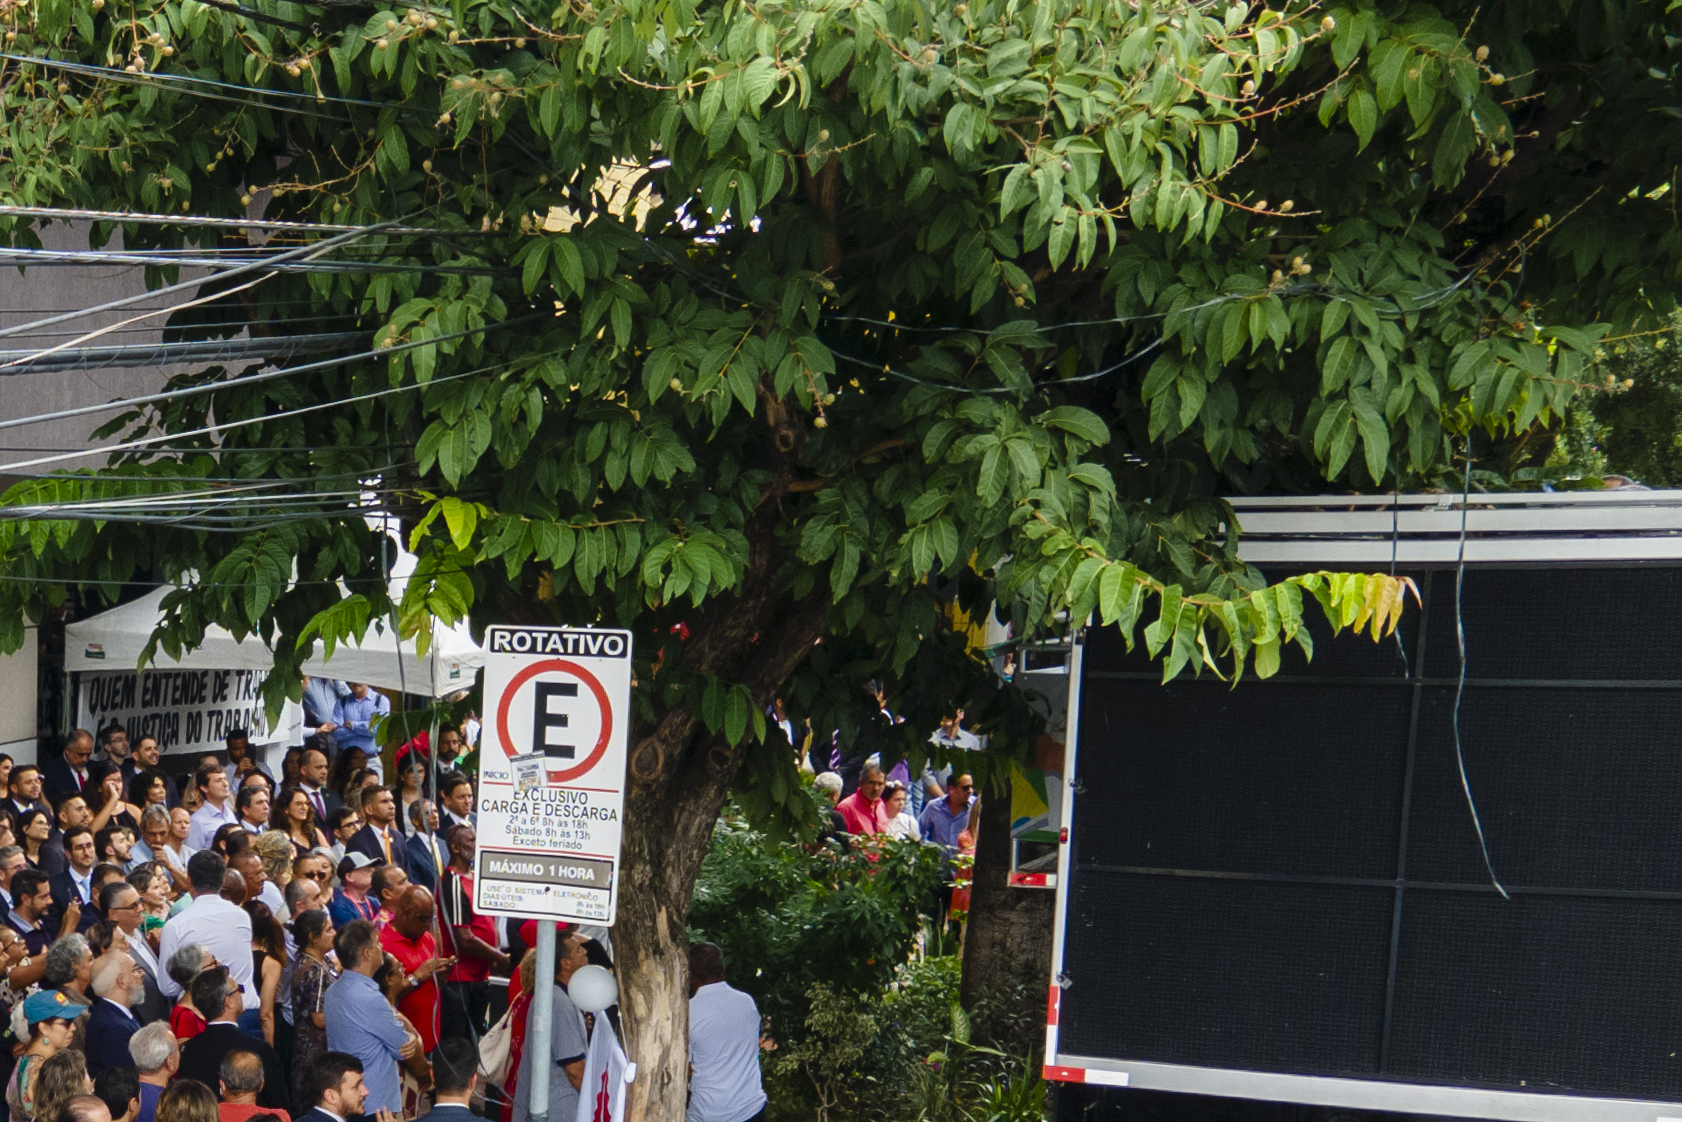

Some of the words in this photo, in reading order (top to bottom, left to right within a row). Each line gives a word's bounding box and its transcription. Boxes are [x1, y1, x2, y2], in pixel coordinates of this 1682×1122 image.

[493, 631, 624, 656] ROTATIVO
[88, 672, 137, 719] QUEM
[141, 669, 209, 710] ENTENDE
[212, 669, 230, 704] DE
[186, 710, 203, 745] DO
[533, 681, 578, 759] E
[513, 787, 588, 806] EXCLUSIVO
[481, 799, 528, 815] CARGA
[532, 803, 540, 816] E
[545, 803, 618, 821] DESCARGA
[513, 836, 546, 847] Exceto
[549, 839, 583, 850] feriado
[489, 859, 544, 876] MÁXIMO
[549, 865, 556, 877] 1
[558, 866, 595, 881] HORA
